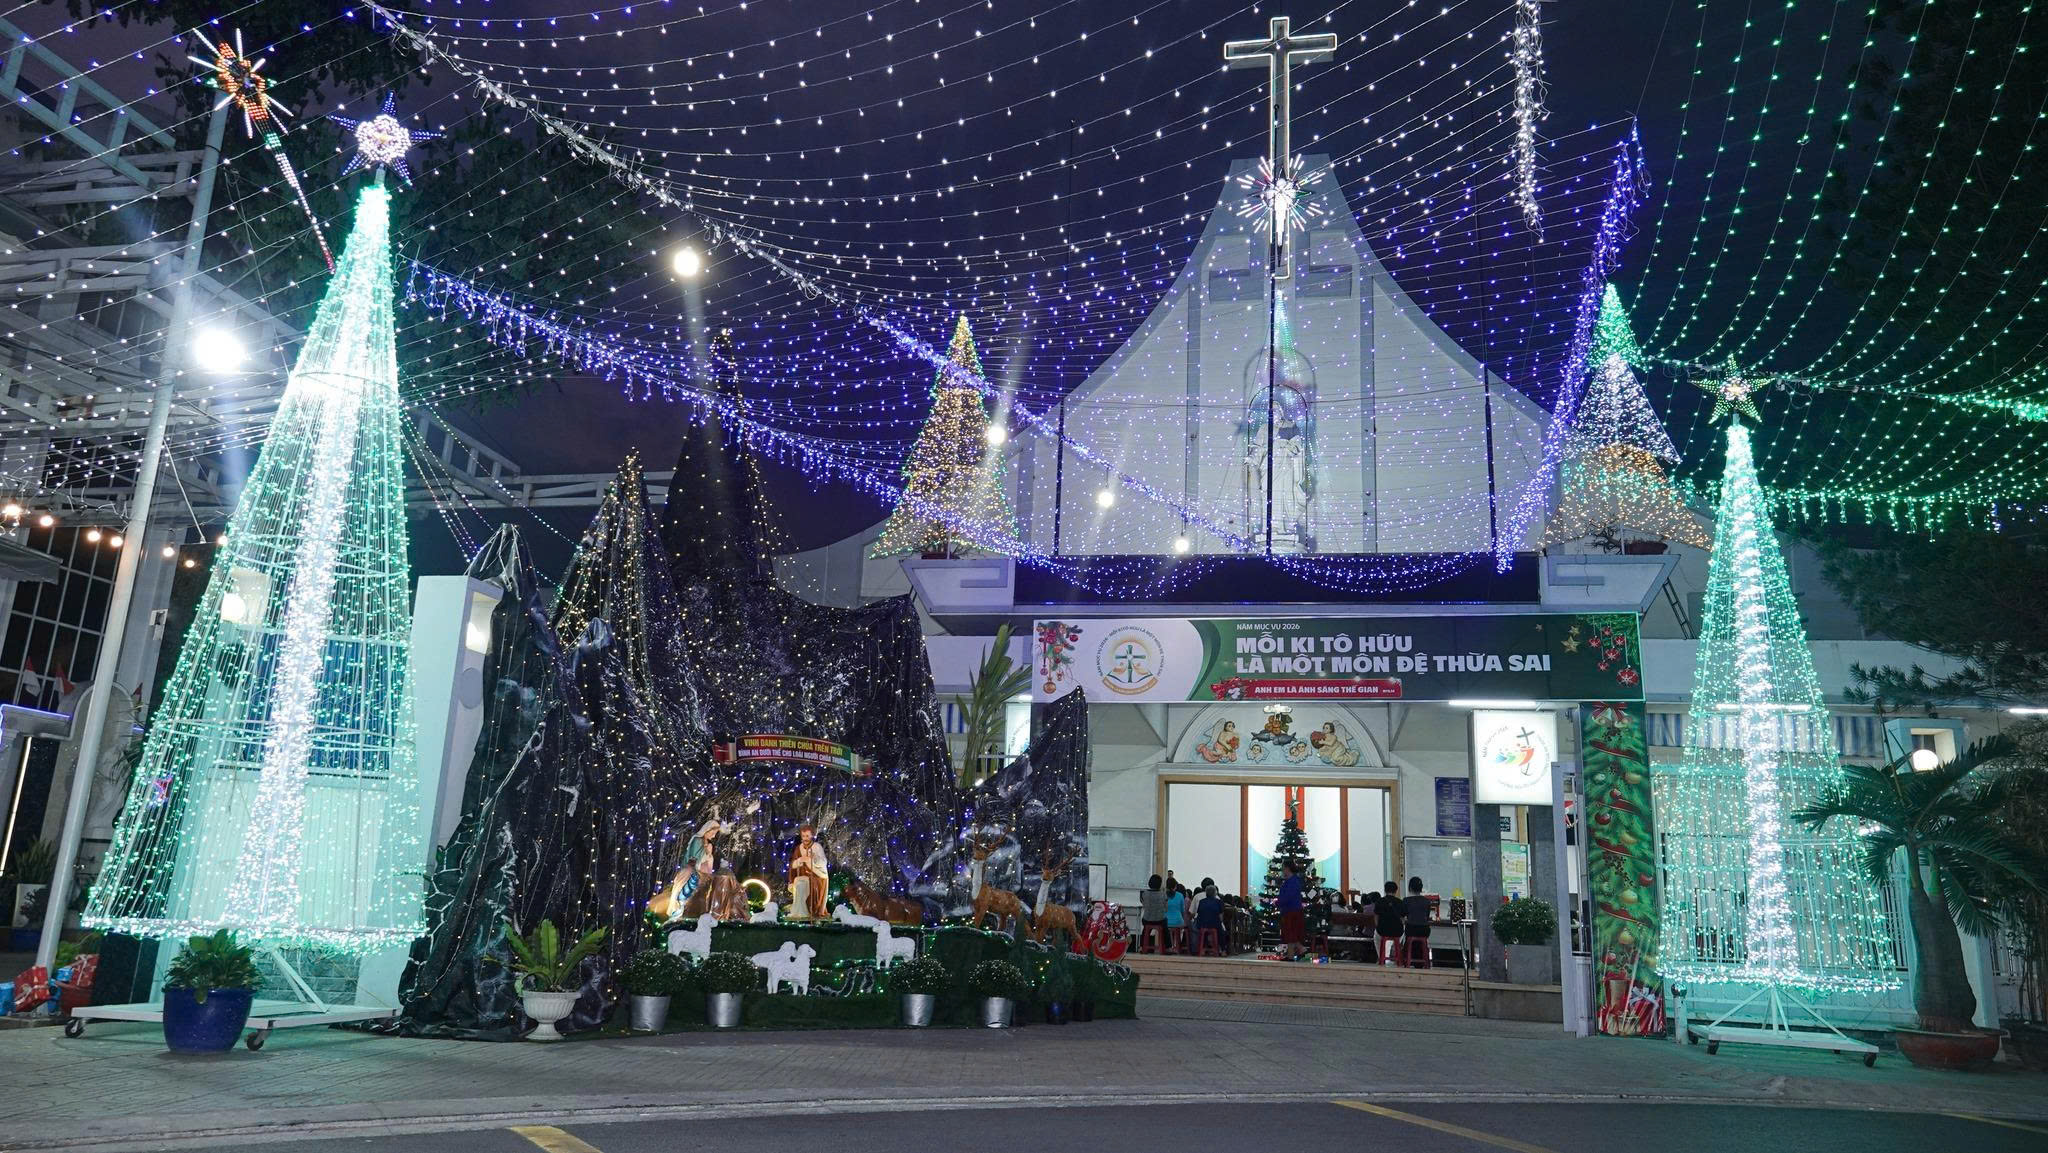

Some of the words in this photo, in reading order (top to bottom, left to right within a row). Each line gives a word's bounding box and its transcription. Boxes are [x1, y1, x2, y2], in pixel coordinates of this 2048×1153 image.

[1236, 631, 1285, 655] MỖI
[1290, 636, 1315, 654] KI
[1320, 632, 1353, 654] TÔ
[1358, 634, 1413, 653] HỮU
[1236, 654, 1266, 673] LÀ
[1271, 654, 1325, 676] MỘT
[1331, 653, 1390, 673] MÔN
[1396, 652, 1428, 675] ĐỆ
[1432, 651, 1504, 673] THỪA
[1508, 654, 1552, 672] SAI
[1254, 686, 1272, 694] ANH
[1273, 686, 1285, 694] EM
[1298, 685, 1316, 694] ÁNH
[1317, 685, 1340, 694] SÁNG
[1340, 684, 1357, 694] THẾ
[1357, 686, 1379, 694] GIAN
[762, 739, 777, 747] DANH
